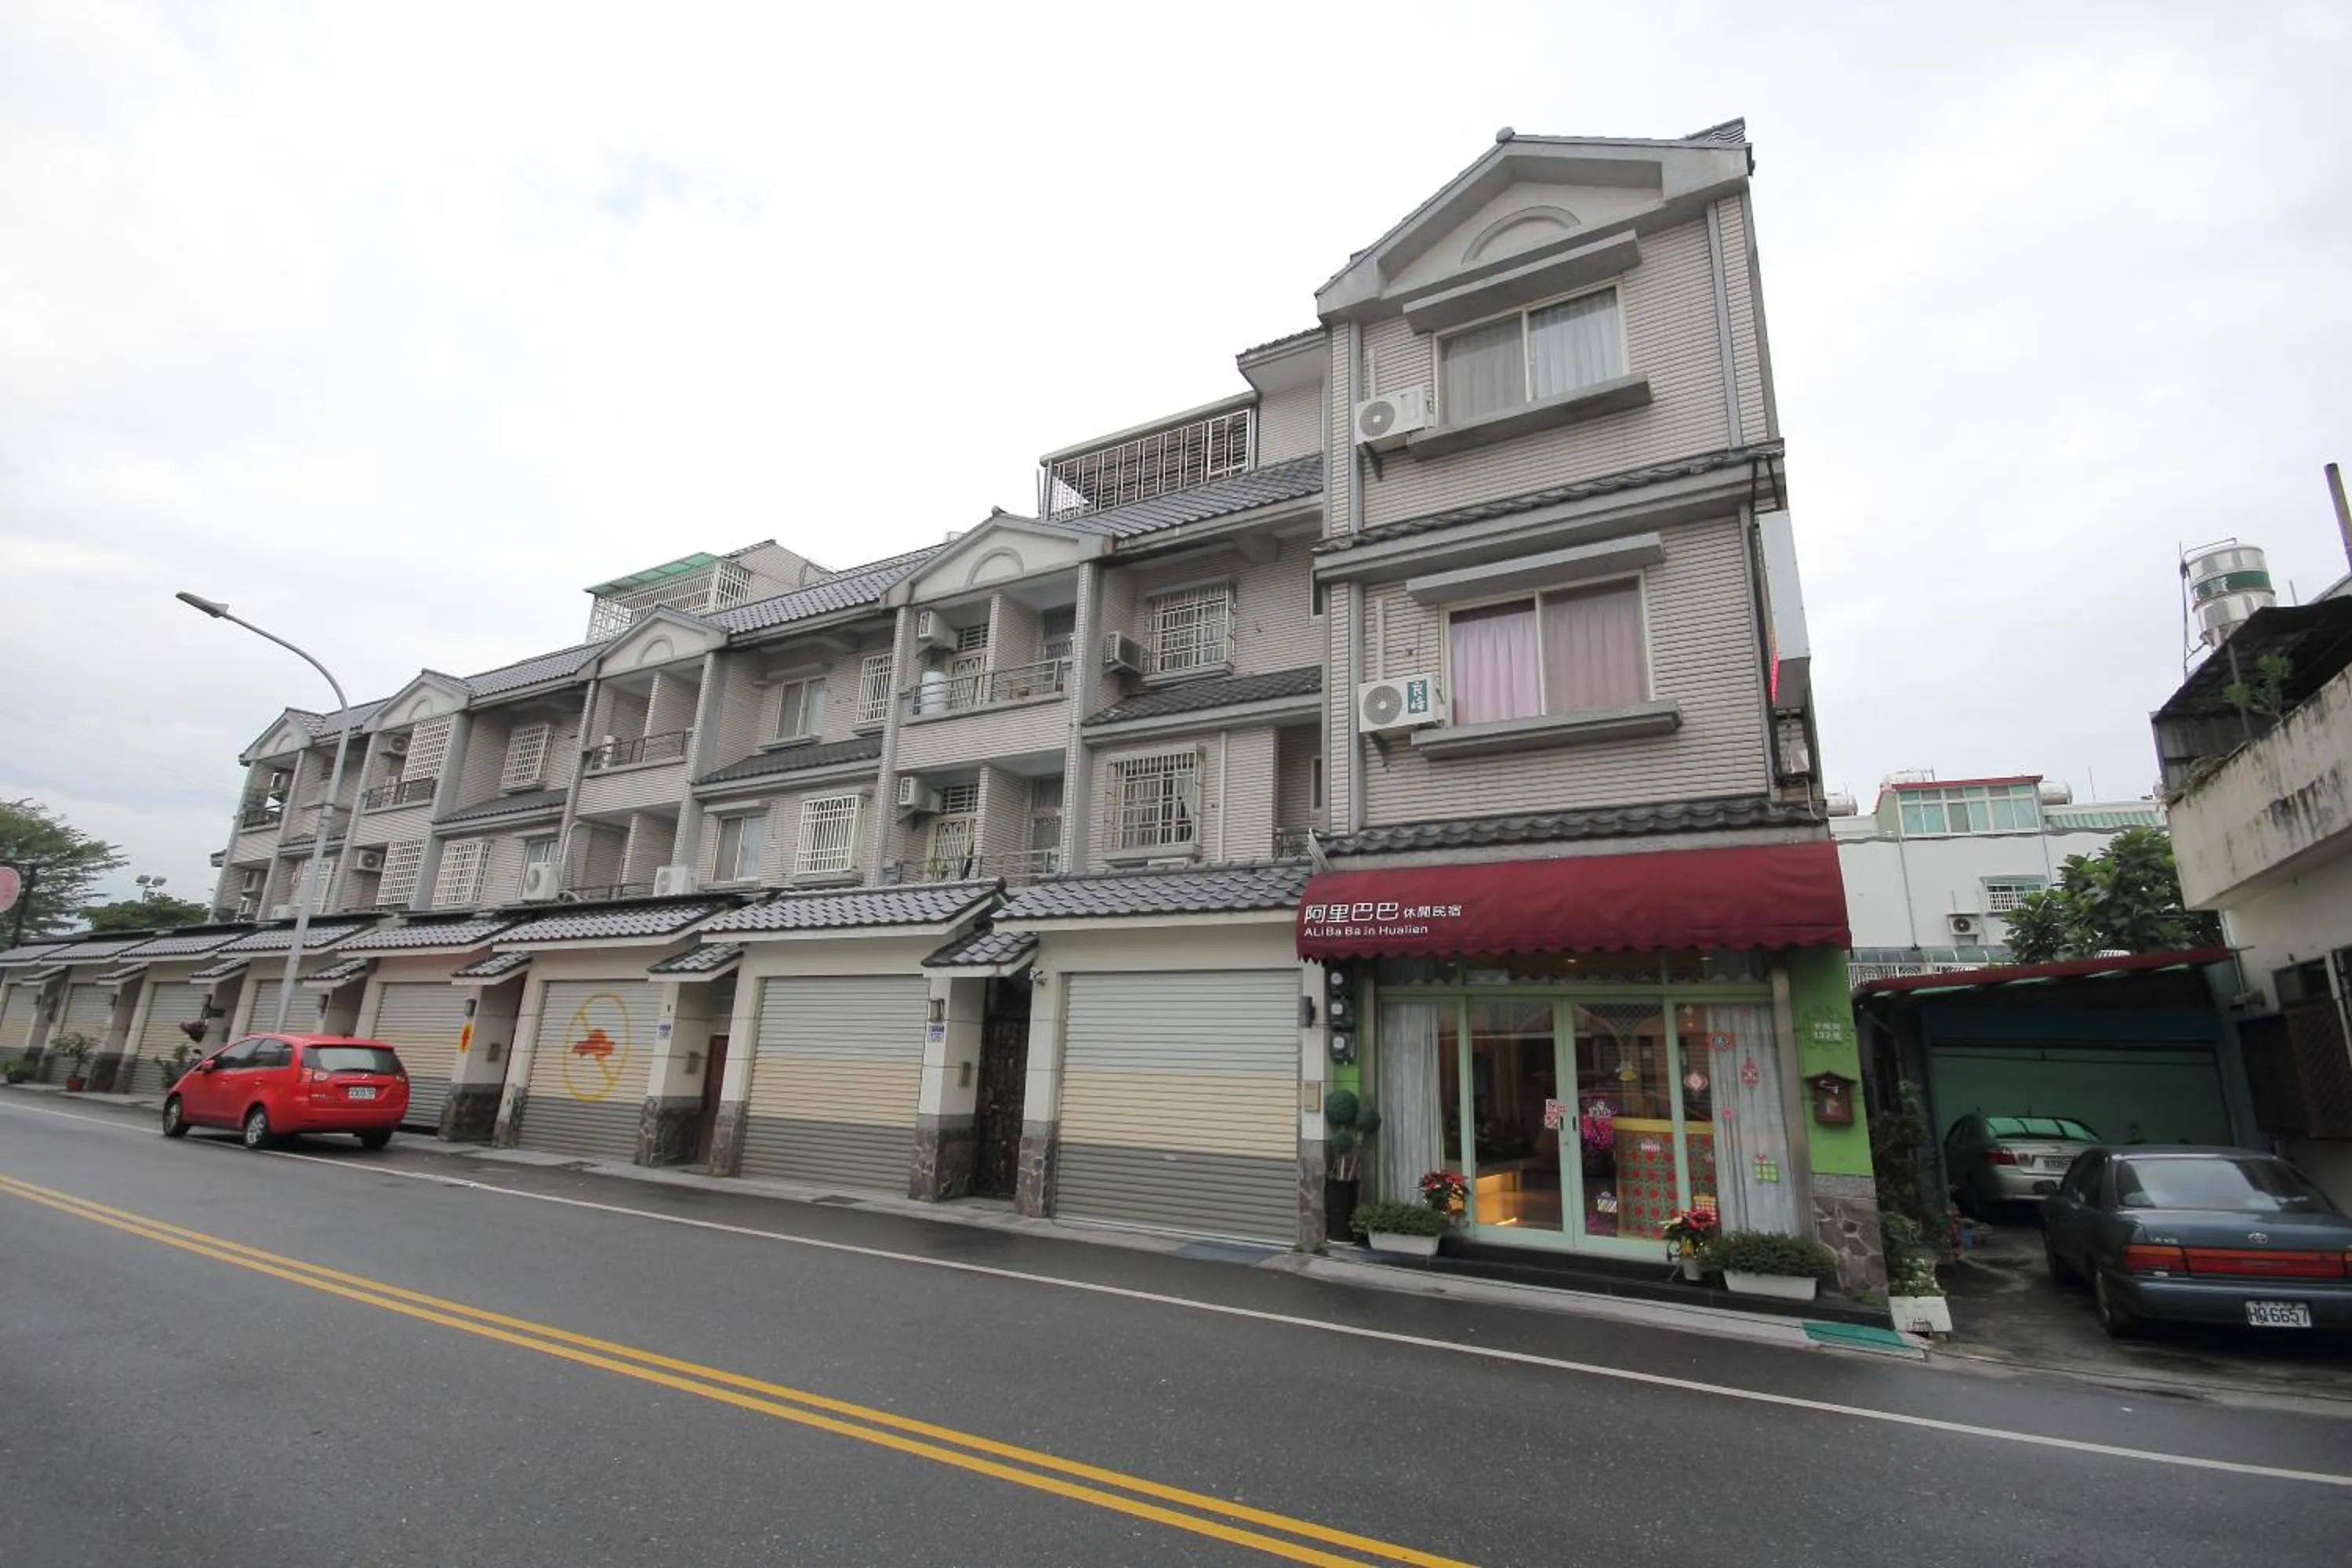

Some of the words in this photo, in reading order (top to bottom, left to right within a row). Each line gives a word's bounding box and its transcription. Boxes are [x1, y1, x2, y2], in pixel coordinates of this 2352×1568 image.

[1304, 902, 1399, 924] 阿里巴巴
[1379, 925, 1428, 935] Hualien
